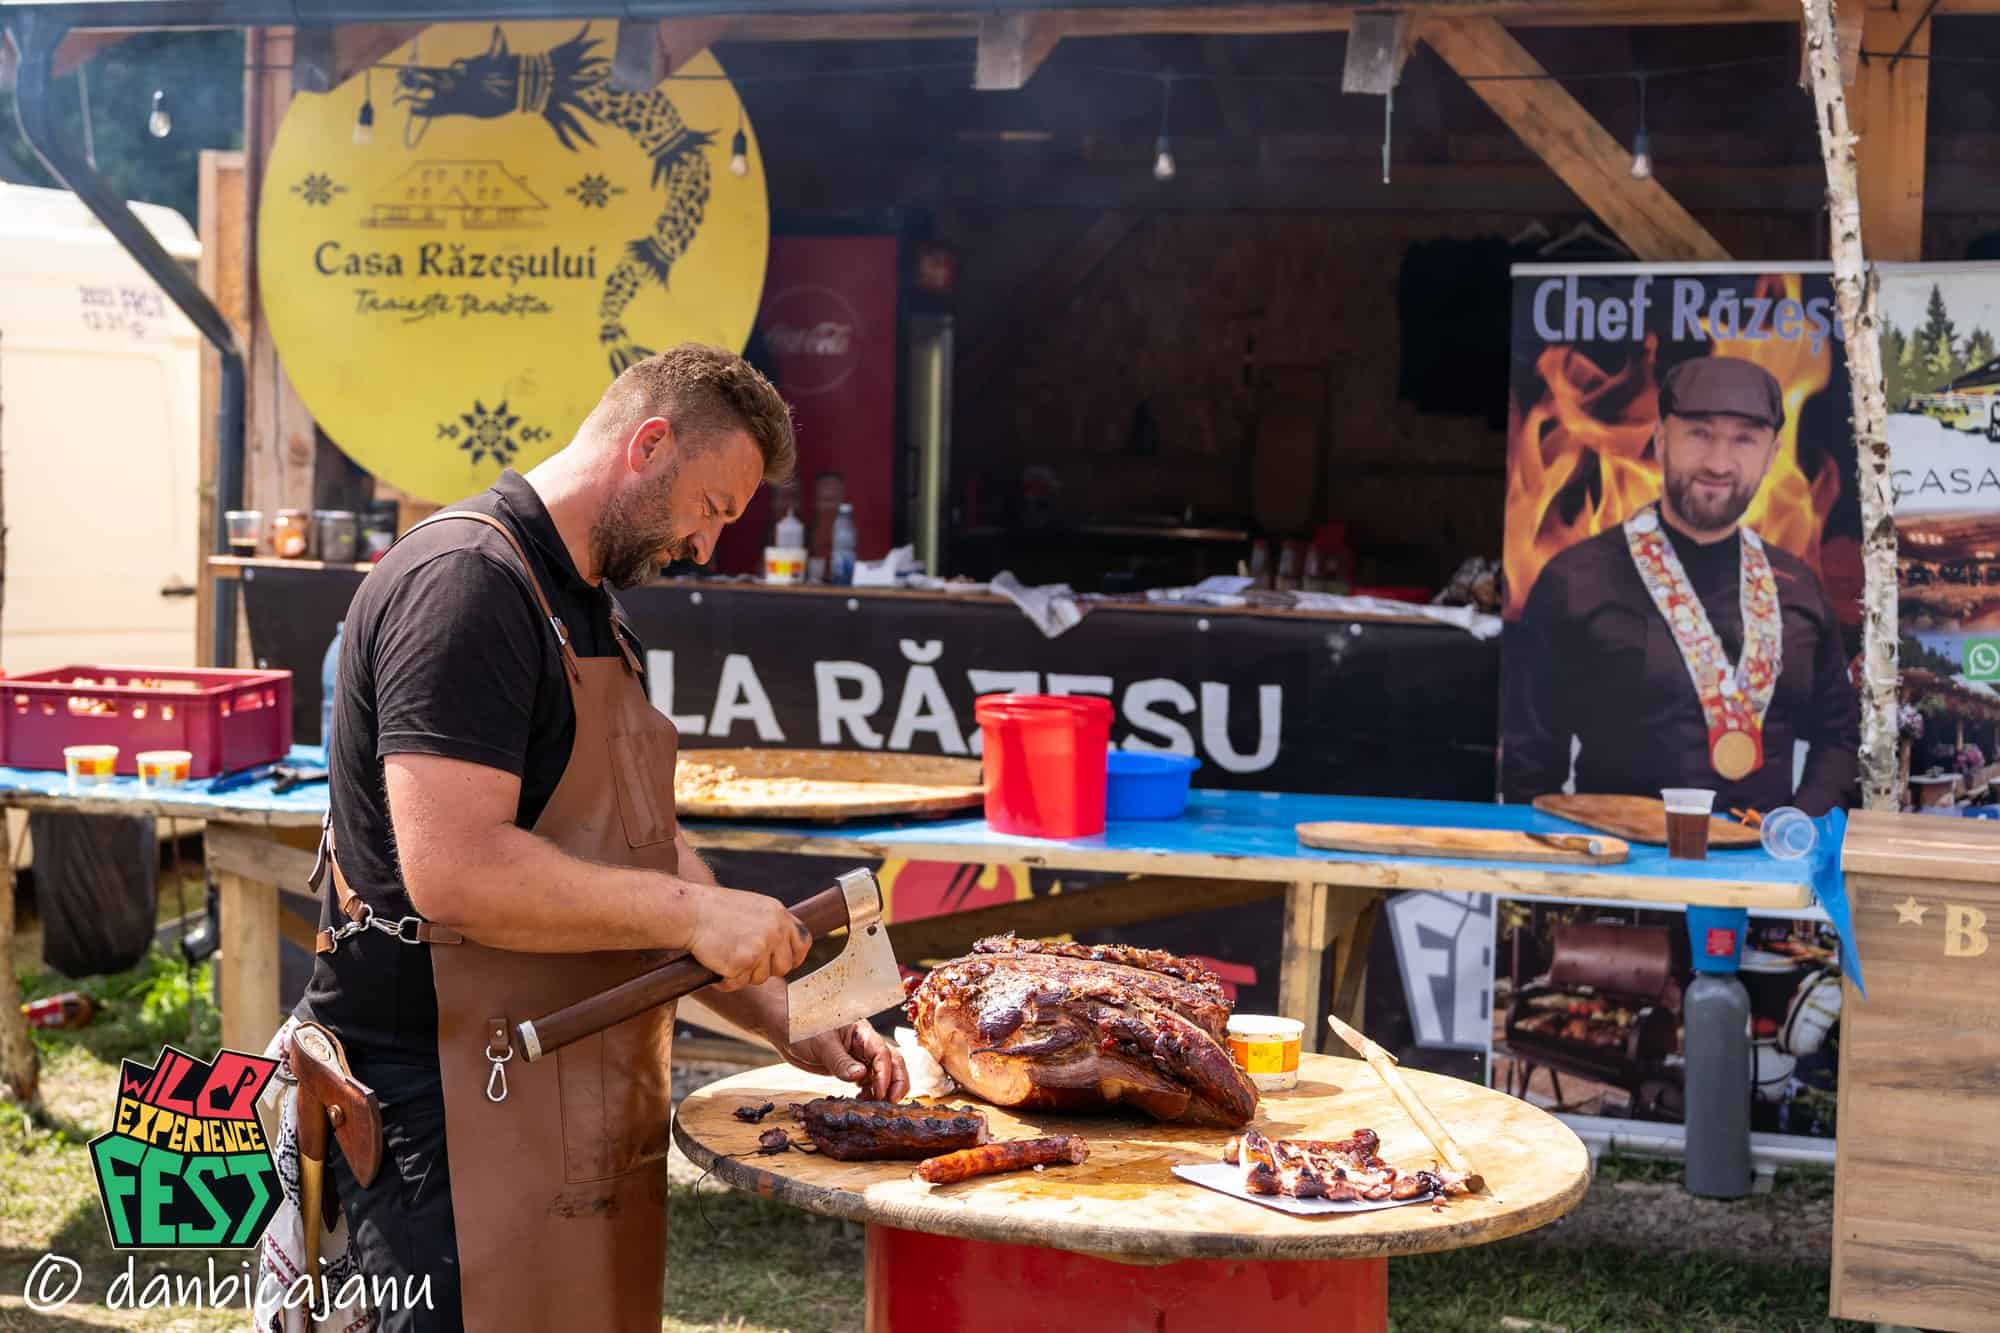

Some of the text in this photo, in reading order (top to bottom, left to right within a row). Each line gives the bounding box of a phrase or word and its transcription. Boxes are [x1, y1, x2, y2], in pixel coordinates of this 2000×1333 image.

[314, 240, 403, 277] Casa
[1533, 275, 1653, 341] Chef
[1890, 467, 2000, 494] CASA
[646, 649, 786, 742] LA
[1943, 903, 1989, 957] B
